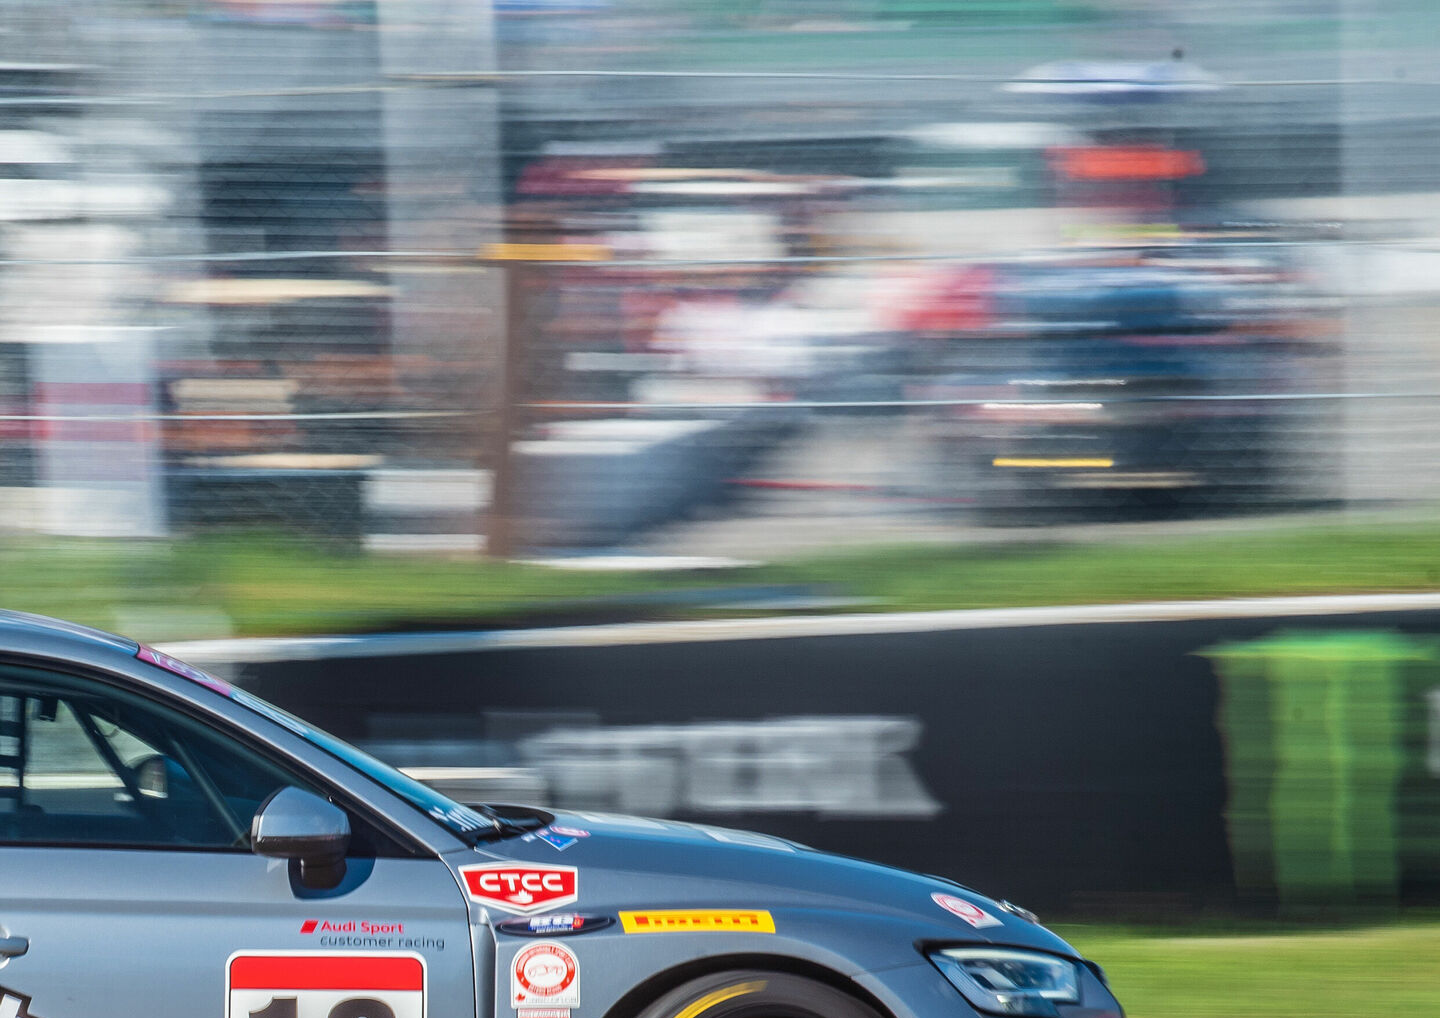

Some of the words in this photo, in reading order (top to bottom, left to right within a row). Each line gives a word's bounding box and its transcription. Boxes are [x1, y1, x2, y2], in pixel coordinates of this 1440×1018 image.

[479, 873, 563, 892] CTCC
[320, 920, 356, 932] Audi
[360, 920, 404, 935] Sport
[320, 935, 393, 947] customer
[398, 935, 445, 950] racing
